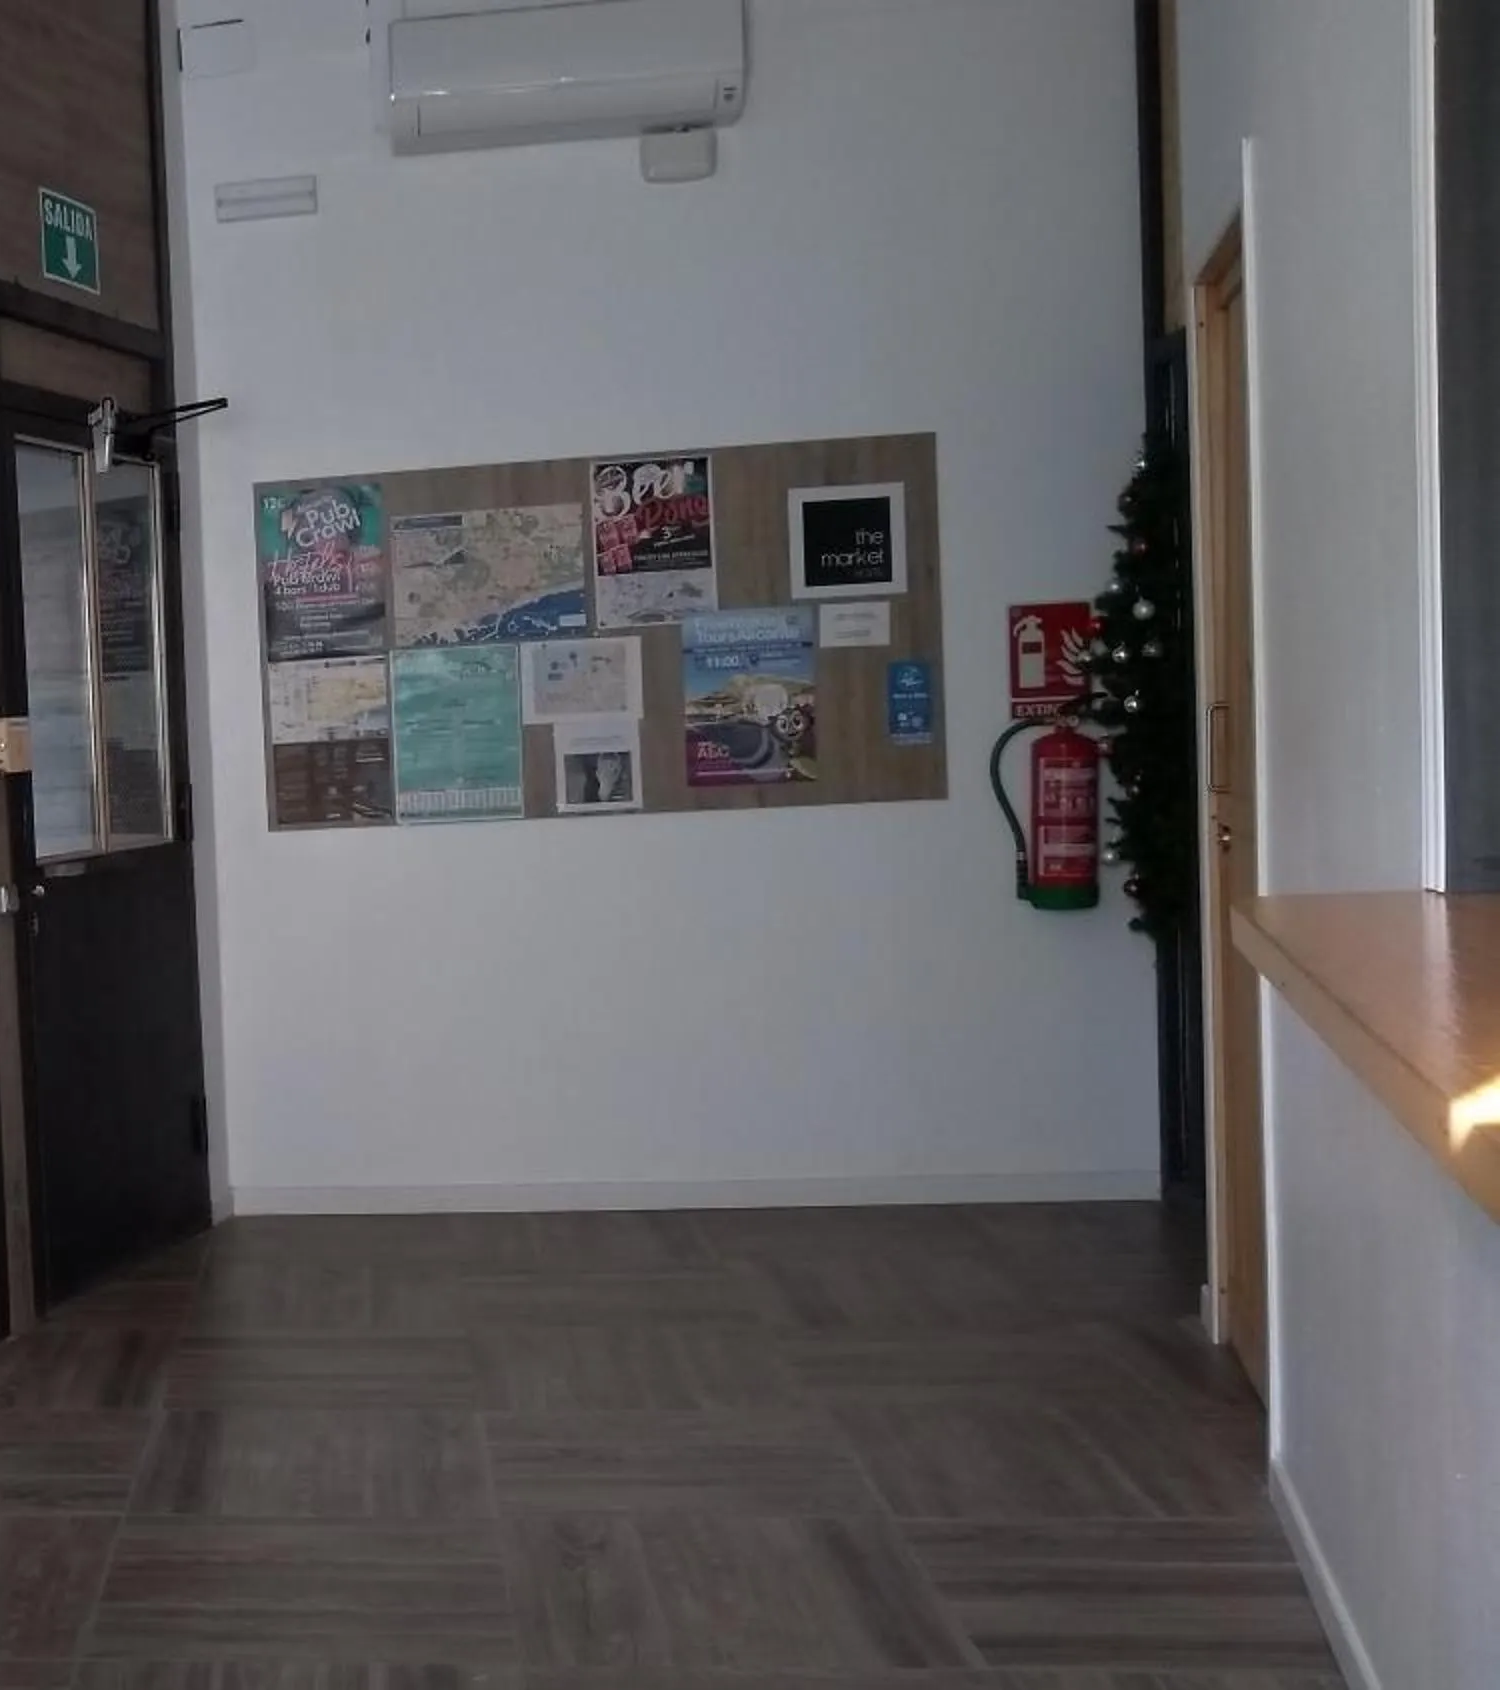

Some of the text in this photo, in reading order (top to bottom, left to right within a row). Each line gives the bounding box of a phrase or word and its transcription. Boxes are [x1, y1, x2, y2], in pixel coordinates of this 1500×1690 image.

[44, 198, 93, 241] SALIDA
[296, 508, 361, 547] Crawl
[306, 499, 350, 528] Pub
[854, 529, 884, 545] the
[820, 548, 884, 567] market
